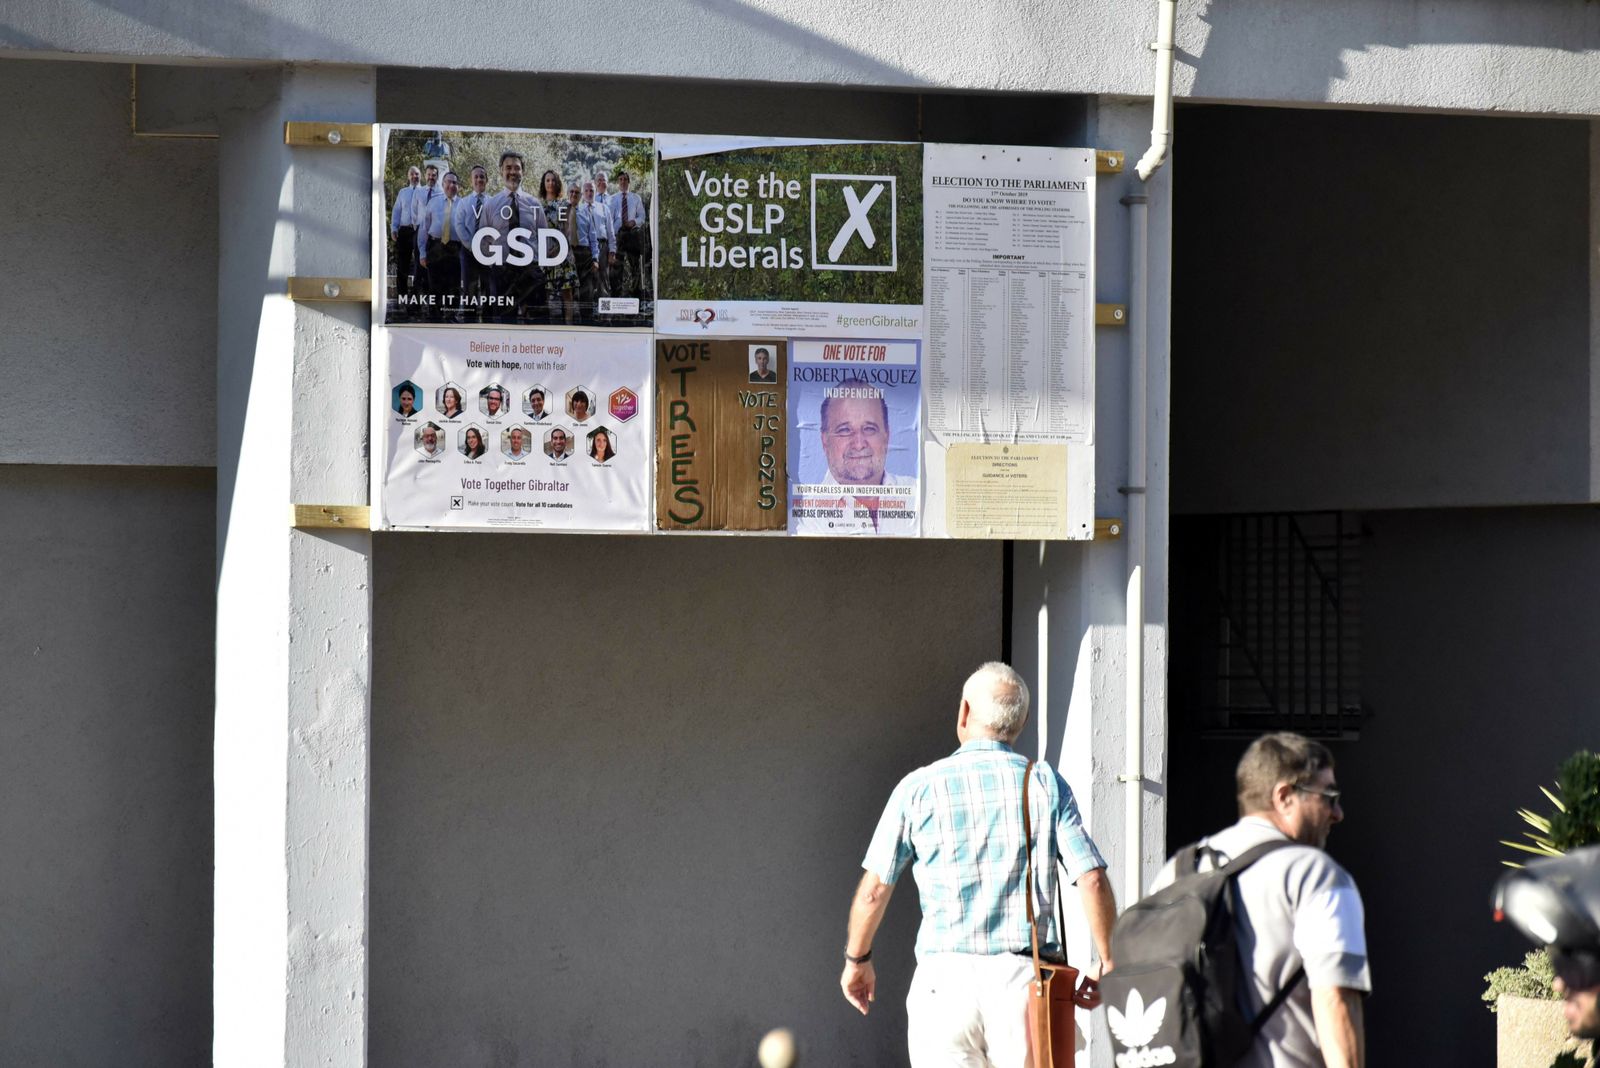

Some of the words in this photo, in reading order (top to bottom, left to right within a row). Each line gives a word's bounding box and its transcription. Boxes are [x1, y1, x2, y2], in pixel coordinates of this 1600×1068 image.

[684, 170, 749, 198] Vote
[757, 171, 801, 199] the
[932, 176, 984, 186] ELECTION
[984, 178, 999, 188] TO
[1002, 178, 1021, 188] THE
[1024, 180, 1088, 190] PARLIAMENT
[471, 204, 568, 222] VOTE
[700, 202, 785, 234] GSLP
[471, 226, 569, 267] GSD
[681, 236, 804, 269] Liberals
[398, 294, 436, 305] MAKE
[442, 295, 455, 305] IT
[460, 295, 515, 306] HAPPEN
[836, 315, 918, 328] #greenGibraltar
[470, 341, 500, 353] Believe
[502, 342, 510, 353] in
[512, 346, 517, 354] a
[520, 343, 545, 354] better
[547, 346, 564, 356] way
[662, 343, 711, 363] VOTE
[823, 344, 842, 360] ONE
[844, 345, 866, 361] VOTE
[868, 346, 886, 361] FOR
[466, 359, 483, 369] Vote
[484, 360, 500, 369] with
[501, 360, 522, 371] hope,
[524, 361, 534, 370] not
[536, 362, 551, 370] with
[553, 362, 567, 371] fear
[793, 367, 849, 383] ROBERT
[852, 368, 917, 387] VASQUEZ
[738, 391, 778, 408] VOTE
[823, 387, 884, 399] INDEPENDENT
[753, 415, 780, 431] JC
[668, 366, 704, 525] TREES
[758, 436, 776, 510] PONS
[461, 478, 482, 490] Vote
[484, 478, 526, 493] Together
[528, 480, 569, 492] Gibraltar
[815, 499, 847, 508] CORRUPTION
[792, 509, 816, 518] INCREASE
[817, 509, 843, 518] OPENNESS
[854, 510, 878, 518] INCREASE
[879, 510, 916, 519] TRANSPARENCY
